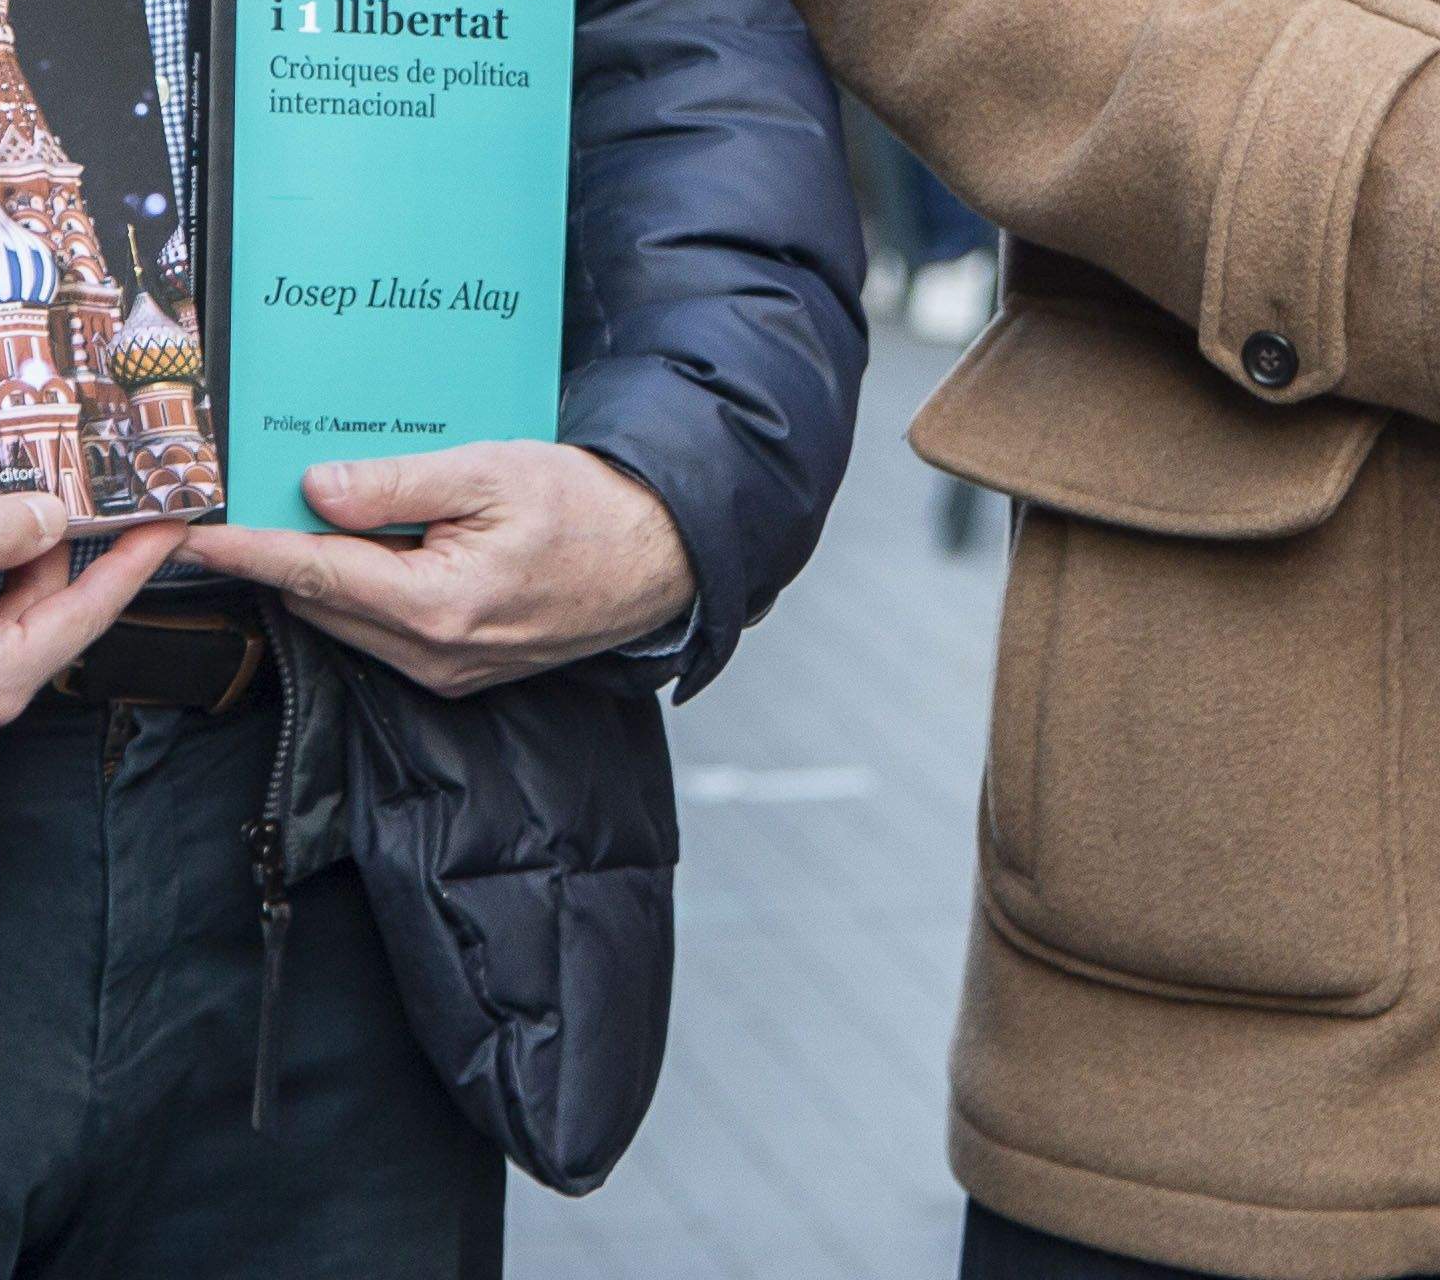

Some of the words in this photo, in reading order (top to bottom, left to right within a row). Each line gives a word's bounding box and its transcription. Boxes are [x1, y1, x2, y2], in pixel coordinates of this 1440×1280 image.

[298, 1, 321, 33] 1
[270, 55, 399, 88] Cròniques
[406, 58, 436, 84] de
[443, 60, 530, 91] política
[269, 89, 436, 118] internacional
[264, 276, 357, 316] Josep
[365, 277, 441, 311] Lluís
[447, 280, 520, 319] Alay
[263, 415, 311, 435] Pròleg
[391, 418, 447, 435] Anwar
